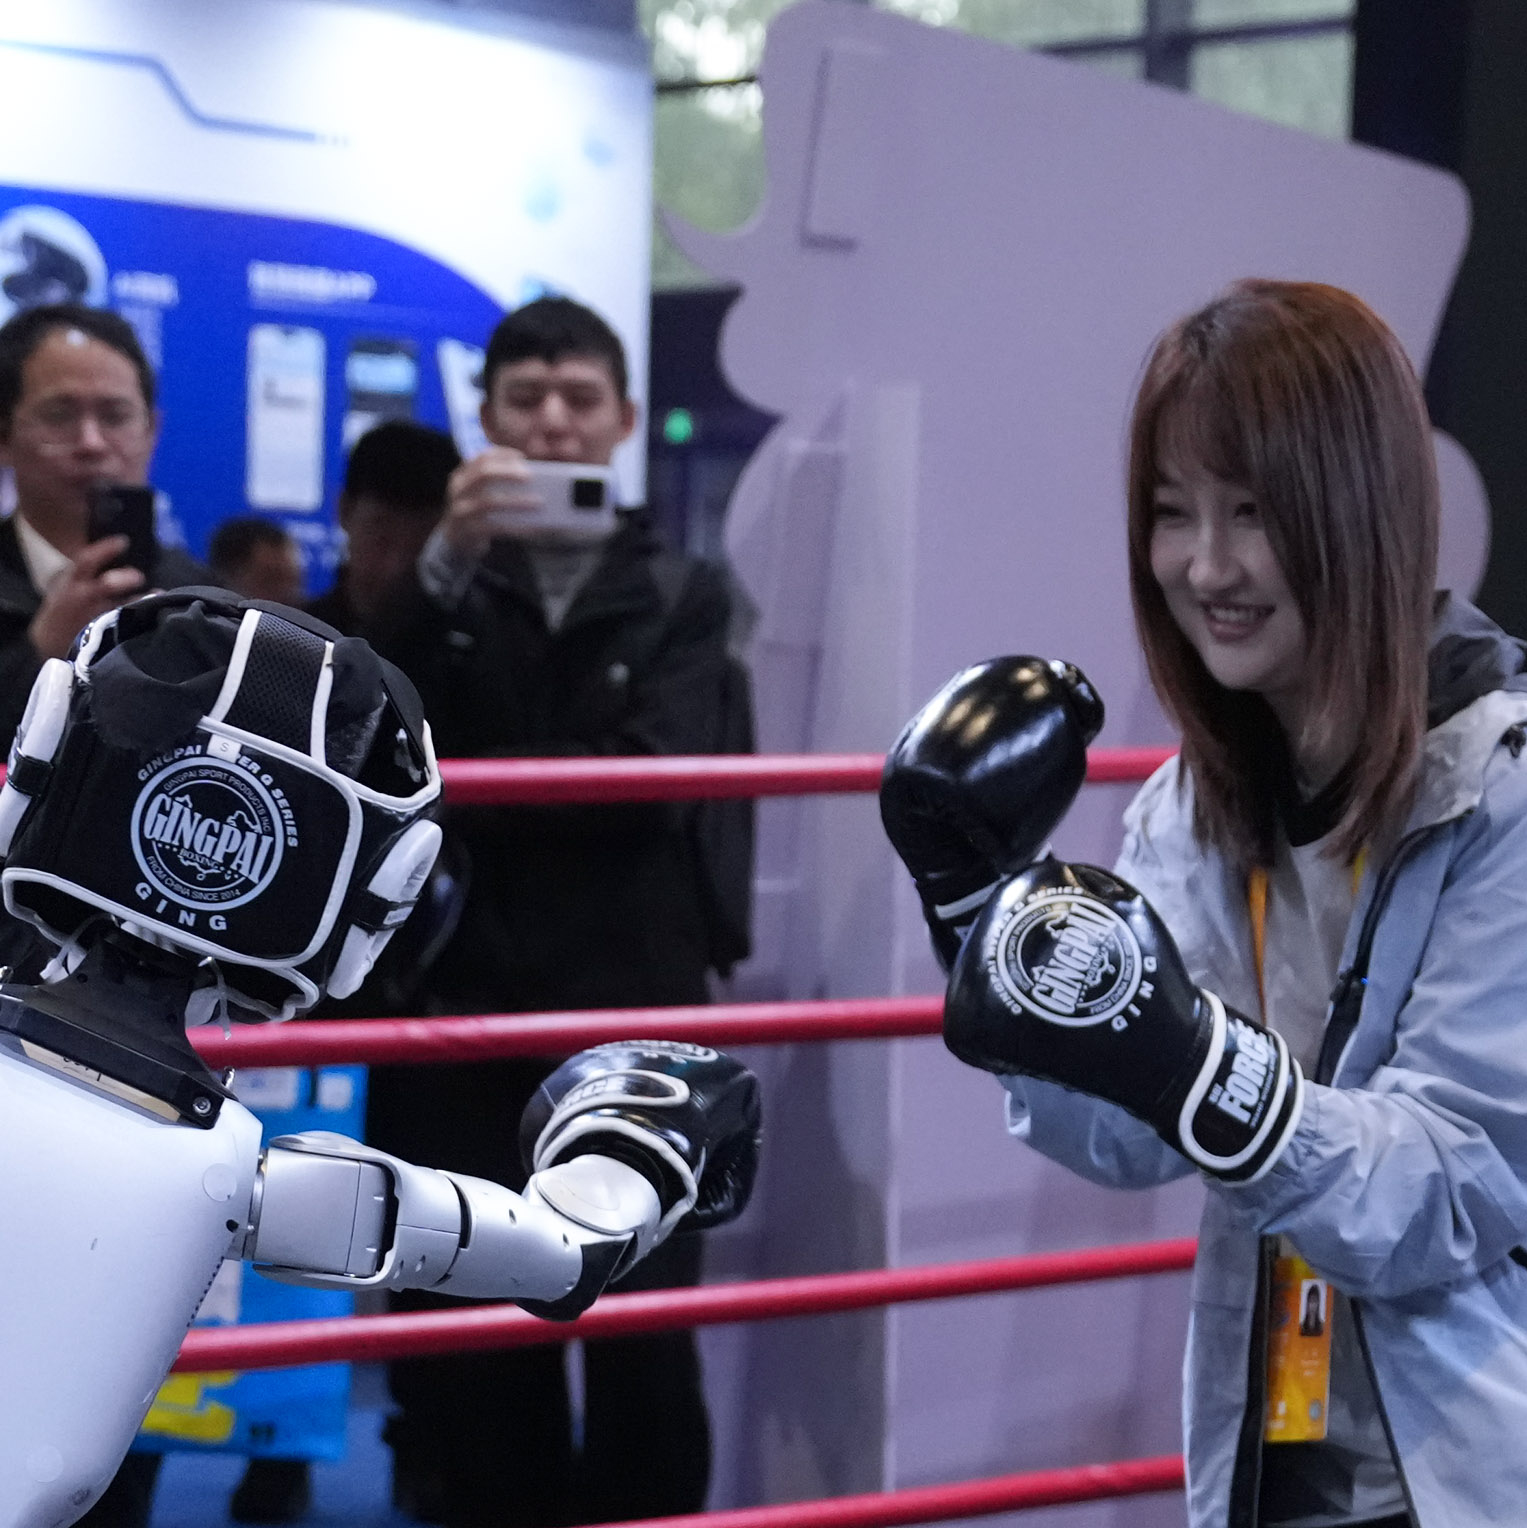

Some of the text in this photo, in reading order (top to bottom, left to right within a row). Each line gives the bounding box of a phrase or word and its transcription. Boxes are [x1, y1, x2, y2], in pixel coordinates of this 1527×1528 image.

[219, 741, 230, 753] S
[199, 768, 229, 784] SPORT
[144, 793, 274, 884] GINGPAI
[271, 788, 299, 848] SERIES
[146, 855, 241, 901] FROM CHINA SINCE 2014
[179, 848, 220, 870] BOXING
[1031, 902, 1118, 1014] GINGPAI
[1217, 1018, 1271, 1124] FORCE
